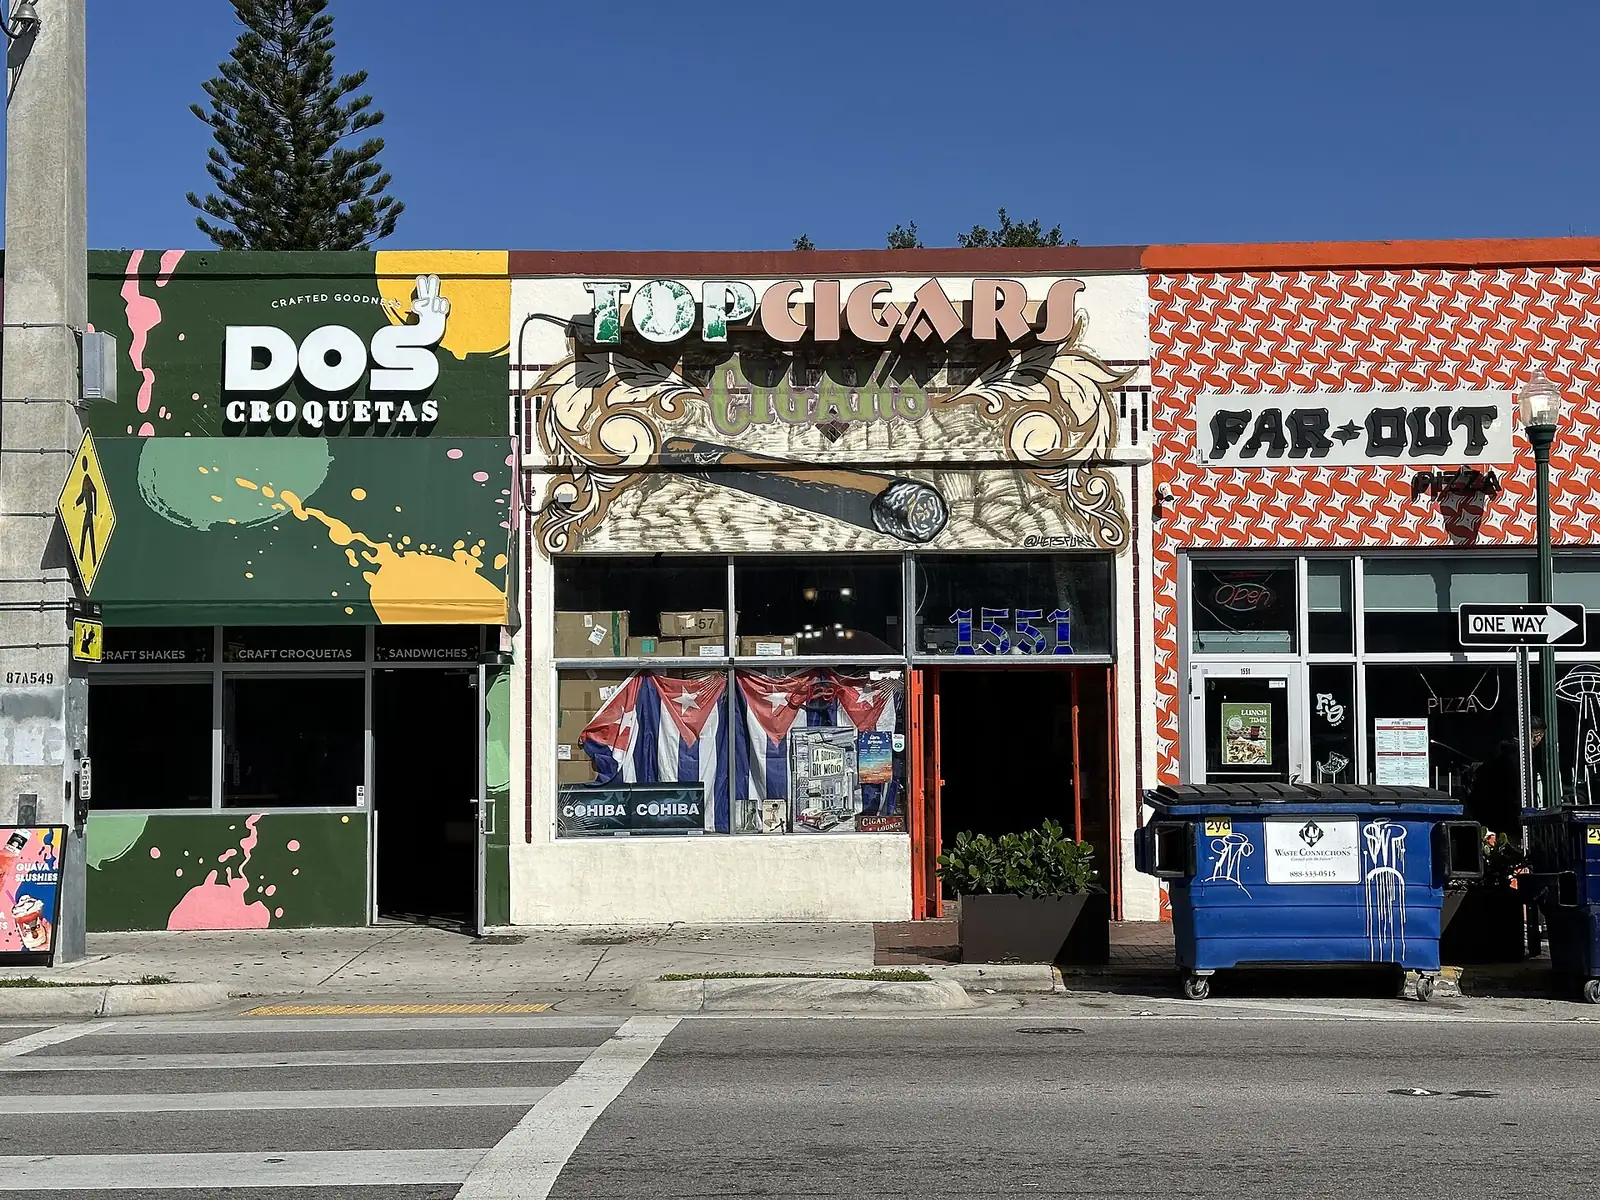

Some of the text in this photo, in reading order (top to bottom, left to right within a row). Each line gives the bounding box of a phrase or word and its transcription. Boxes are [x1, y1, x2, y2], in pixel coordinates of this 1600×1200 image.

[271, 293, 402, 309] CRAFTED GOODNESS
[583, 277, 1086, 346] TOP CIGARS
[224, 322, 446, 393] DOS
[225, 400, 439, 429] CROQUETAS
[1208, 405, 1499, 459] FAR OUT
[1413, 470, 1502, 498] PIZZA
[1215, 584, 1272, 606] Open
[948, 606, 1075, 656] 1551
[1472, 616, 1546, 633] ONE WAY
[139, 650, 186, 660] SHAKES
[238, 649, 352, 660] CRAFT CROQUETAS
[388, 648, 468, 659] SANDWICHES
[6, 671, 54, 685] 87A549
[1427, 696, 1478, 714] PIZZA
[1249, 716, 1267, 724] TIME
[562, 803, 700, 818] COHIBA COHIBA
[862, 817, 887, 827] CIGAR
[1206, 819, 1231, 833] 2yd
[1274, 847, 1351, 857] WASTE CONNECTIONS
[16, 862, 50, 872] GUAVA
[15, 873, 59, 882] SLUSHIES
